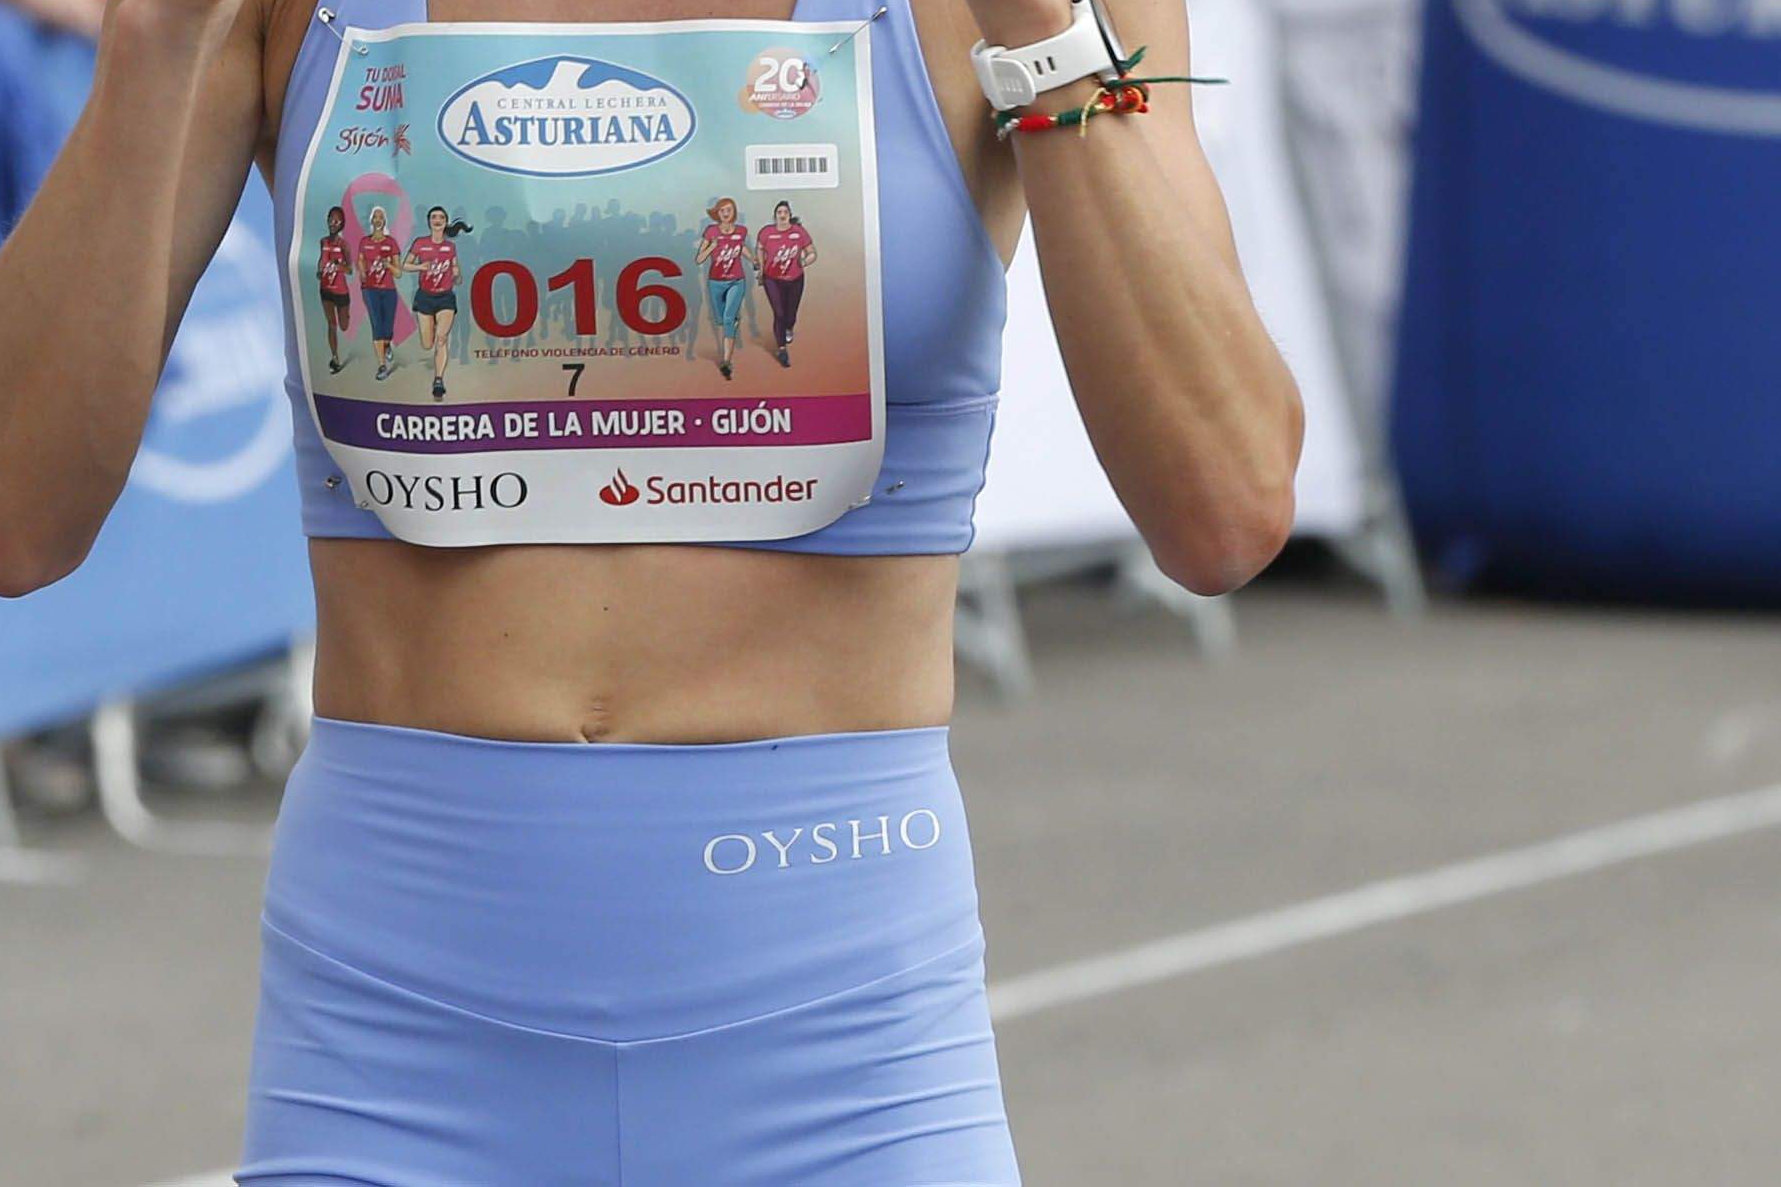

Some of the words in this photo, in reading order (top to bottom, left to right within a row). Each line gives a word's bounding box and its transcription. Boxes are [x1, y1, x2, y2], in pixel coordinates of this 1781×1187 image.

[754, 57, 806, 92] 20
[497, 97, 578, 110] CENTRAL
[585, 96, 667, 109] LECHERA
[457, 100, 678, 146] ASTURIANA
[470, 256, 687, 338] 016
[542, 347, 608, 357] VIOLENCIA
[610, 347, 625, 357] DE
[562, 364, 585, 397] 7
[376, 413, 495, 441] CARRERA
[504, 412, 539, 438] DE
[549, 412, 583, 437] LA
[592, 410, 686, 436] MUJER
[712, 401, 791, 435] GIJÓN
[366, 470, 528, 511] OYSHO
[646, 475, 819, 505] Santander
[703, 809, 940, 874] OYSHO
